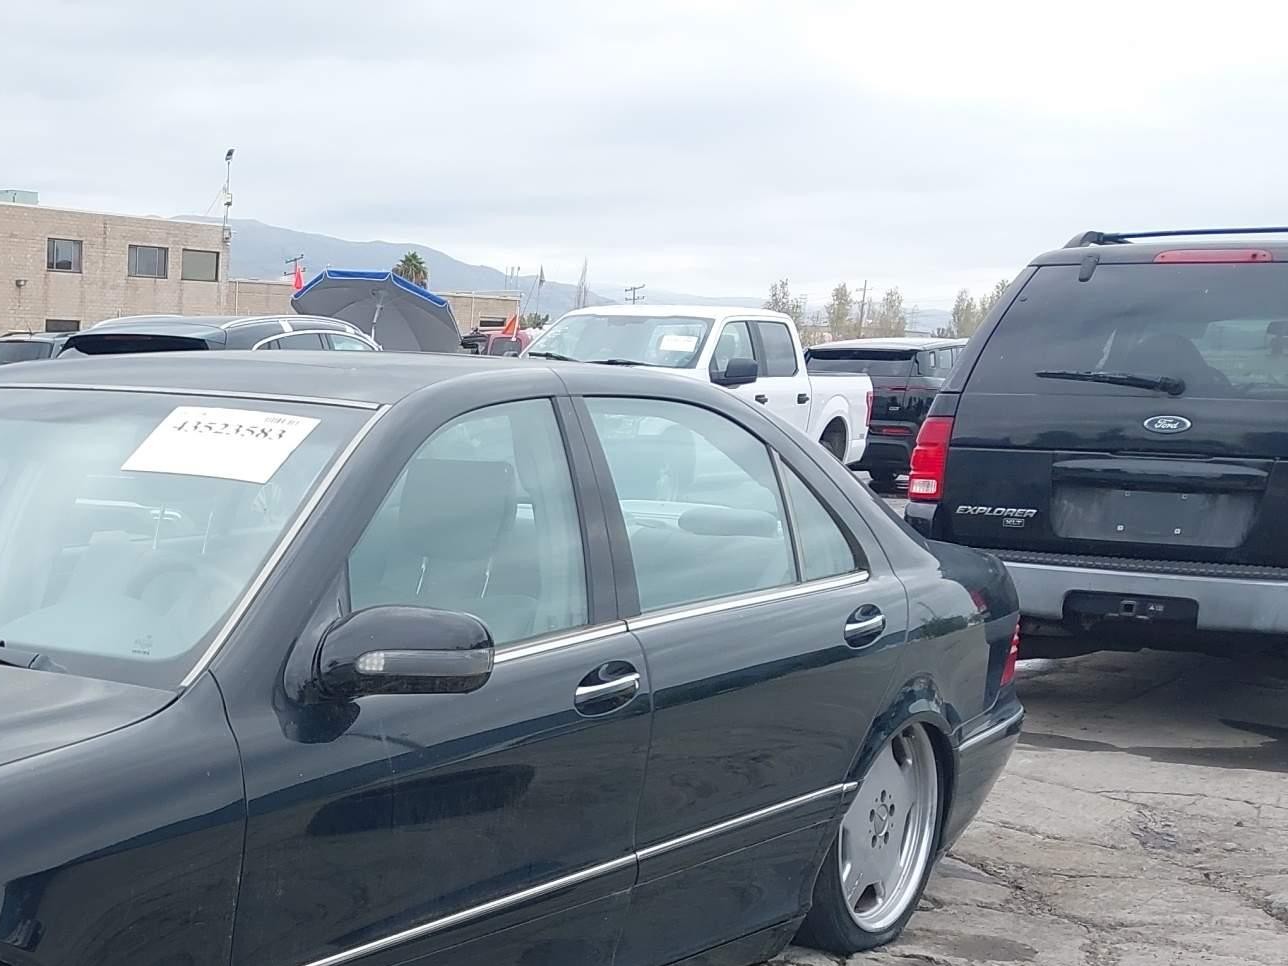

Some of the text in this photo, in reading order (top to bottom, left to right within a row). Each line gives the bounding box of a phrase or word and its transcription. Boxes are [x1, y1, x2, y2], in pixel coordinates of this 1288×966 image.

[172, 420, 286, 440] 43523583
[1154, 418, 1180, 429] Ford
[955, 505, 1037, 518] EXPLORER
